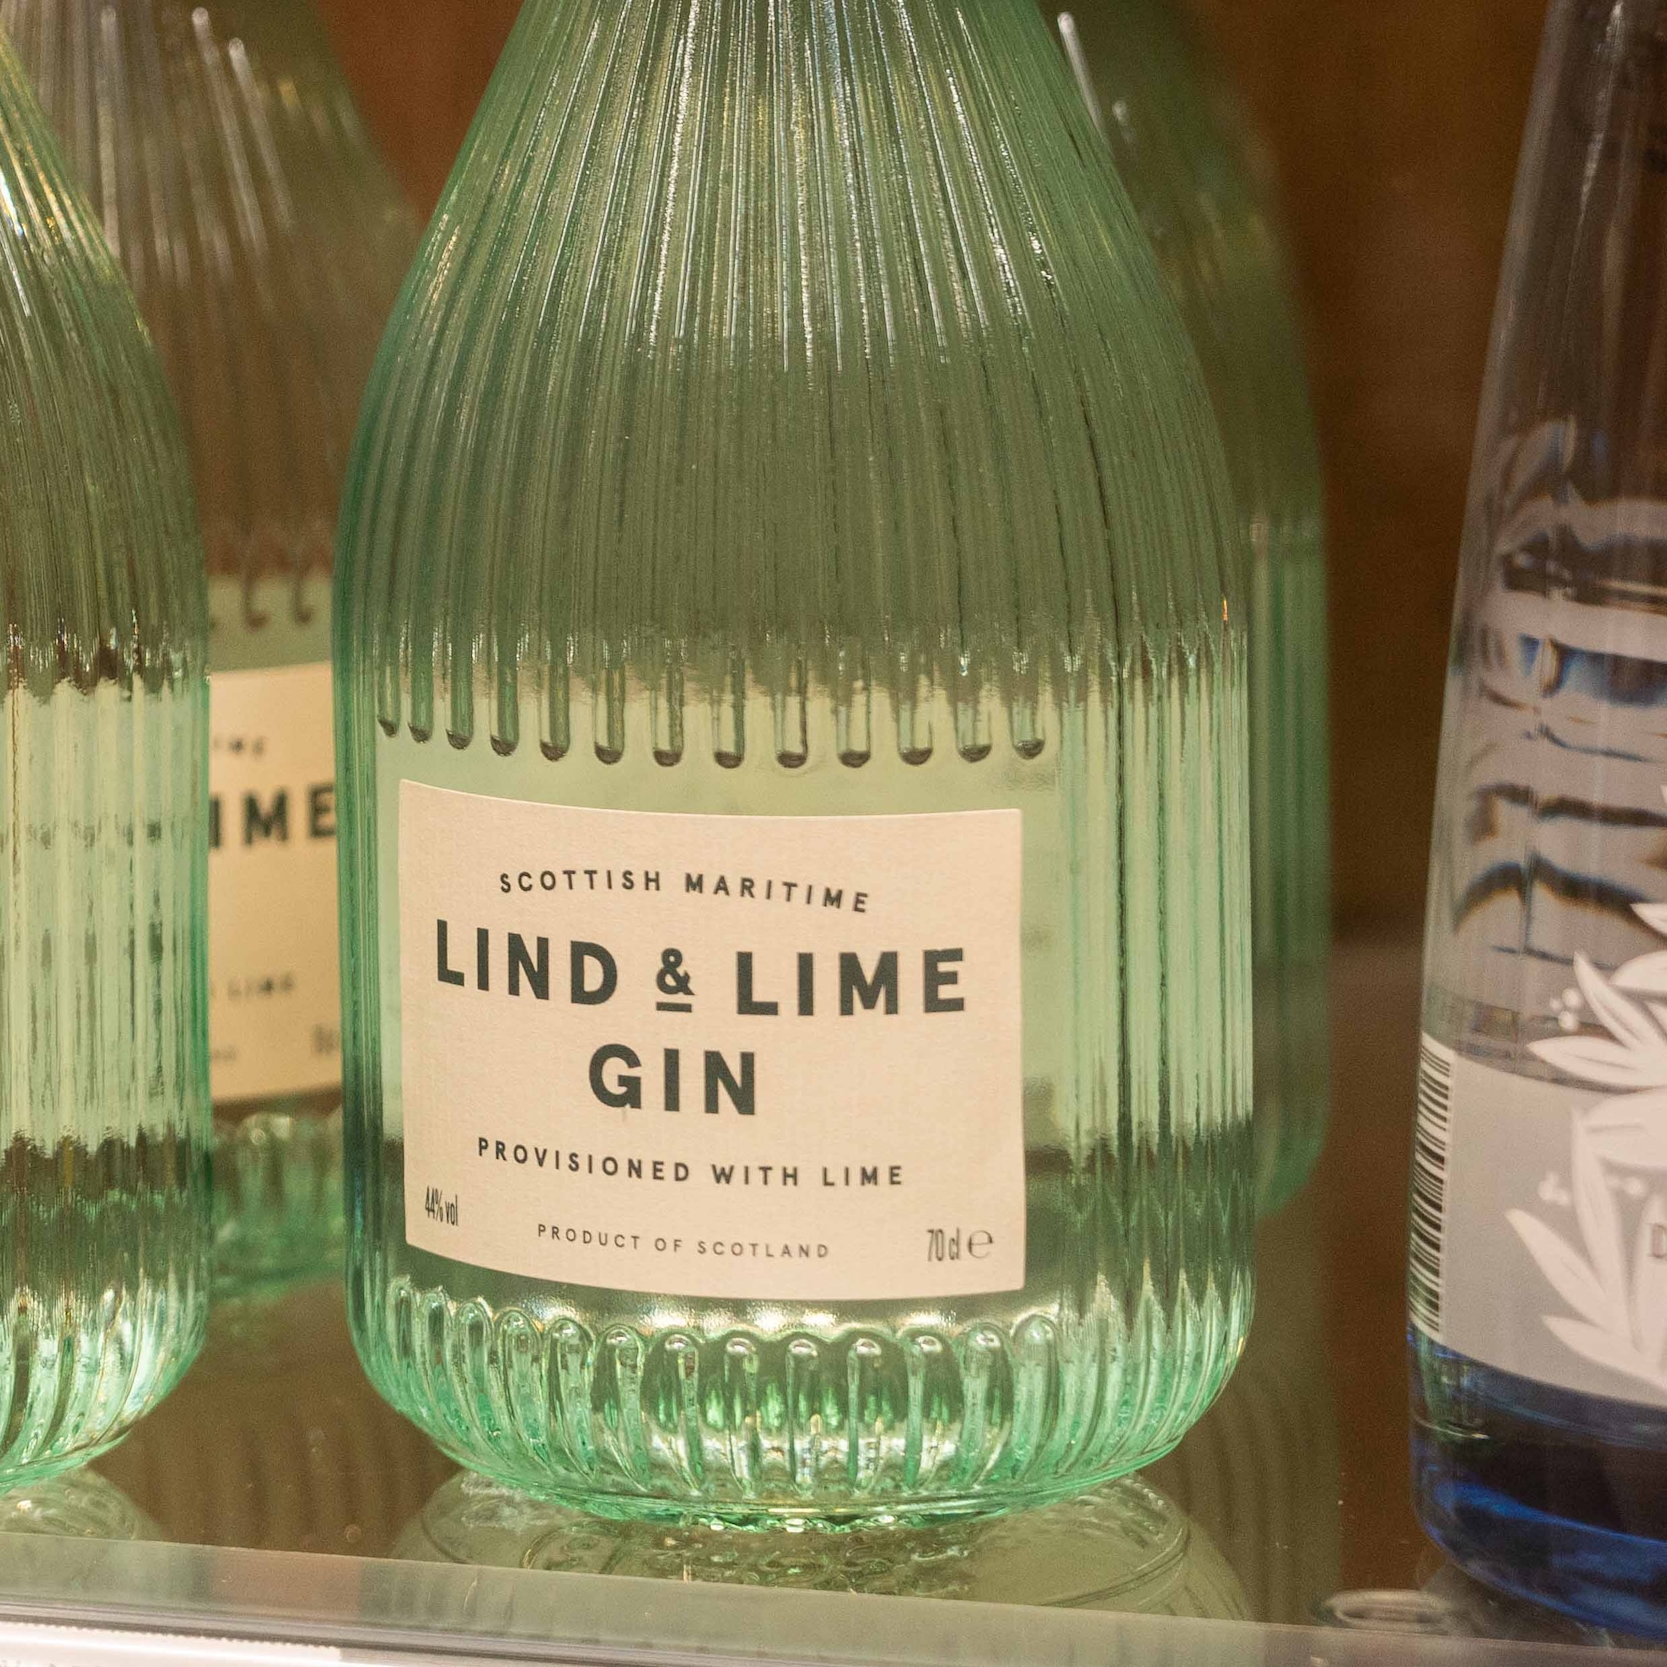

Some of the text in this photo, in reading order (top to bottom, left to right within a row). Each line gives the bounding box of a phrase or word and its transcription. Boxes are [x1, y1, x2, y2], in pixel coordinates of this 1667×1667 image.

[208, 784, 336, 847] IME
[500, 870, 870, 914] SCOTTISH MARITIME
[436, 918, 966, 1017] LIND & LIME
[588, 1043, 756, 1116] GIN
[478, 1136, 903, 1188] PROVISIONED WITH LIME
[445, 1196, 459, 1227] vol
[538, 1223, 830, 1260] PRODUCT OF SCOTLAND
